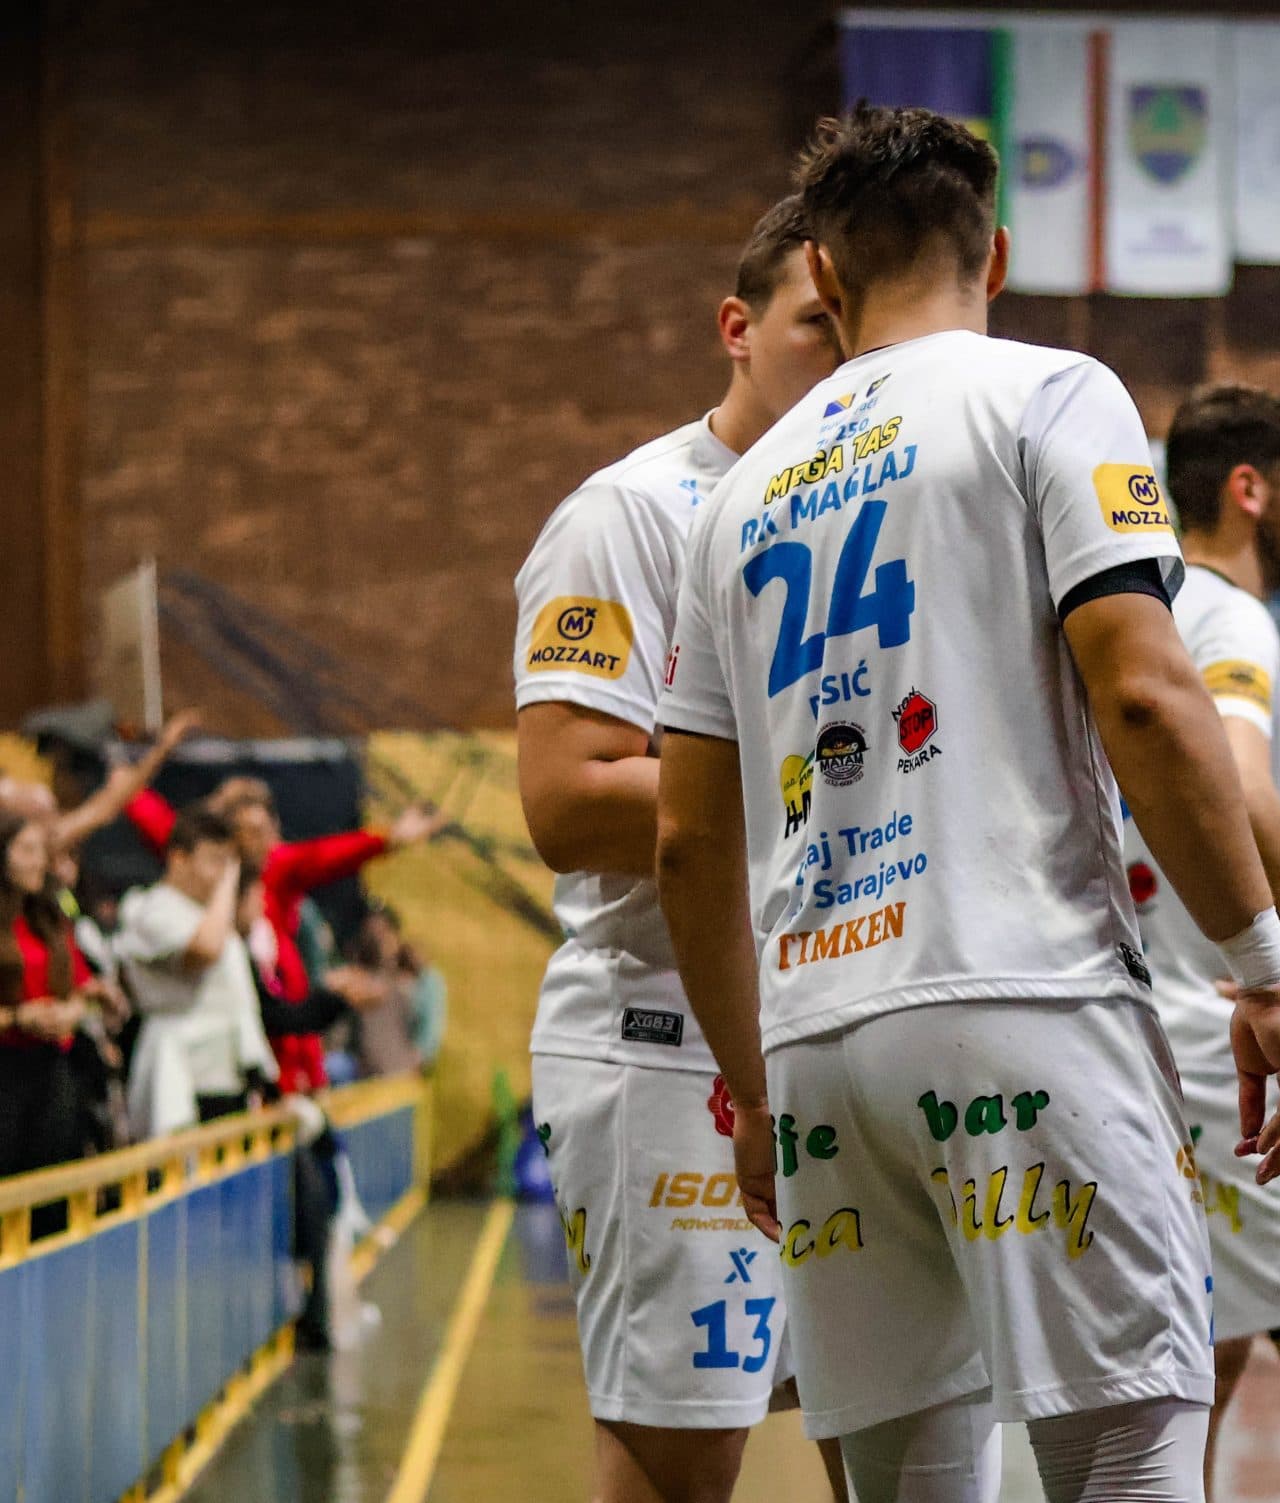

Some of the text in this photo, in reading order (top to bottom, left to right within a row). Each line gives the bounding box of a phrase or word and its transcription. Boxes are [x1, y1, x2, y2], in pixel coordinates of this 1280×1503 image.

[764, 445, 844, 505] MEGA
[852, 415, 903, 466] TAS
[740, 443, 918, 552] RK MAGLAJ
[743, 500, 915, 698] 24
[528, 645, 622, 672] MOZZART
[809, 660, 871, 720] SIĆ
[899, 708, 934, 741] STOP
[897, 743, 943, 775] PEKARA
[838, 811, 913, 857] Trade
[813, 852, 928, 910] Sarajevo
[778, 901, 907, 971] TIMKEN
[917, 1089, 1051, 1142] bar
[648, 1171, 746, 1209] ISO
[690, 1297, 776, 1374] 13
